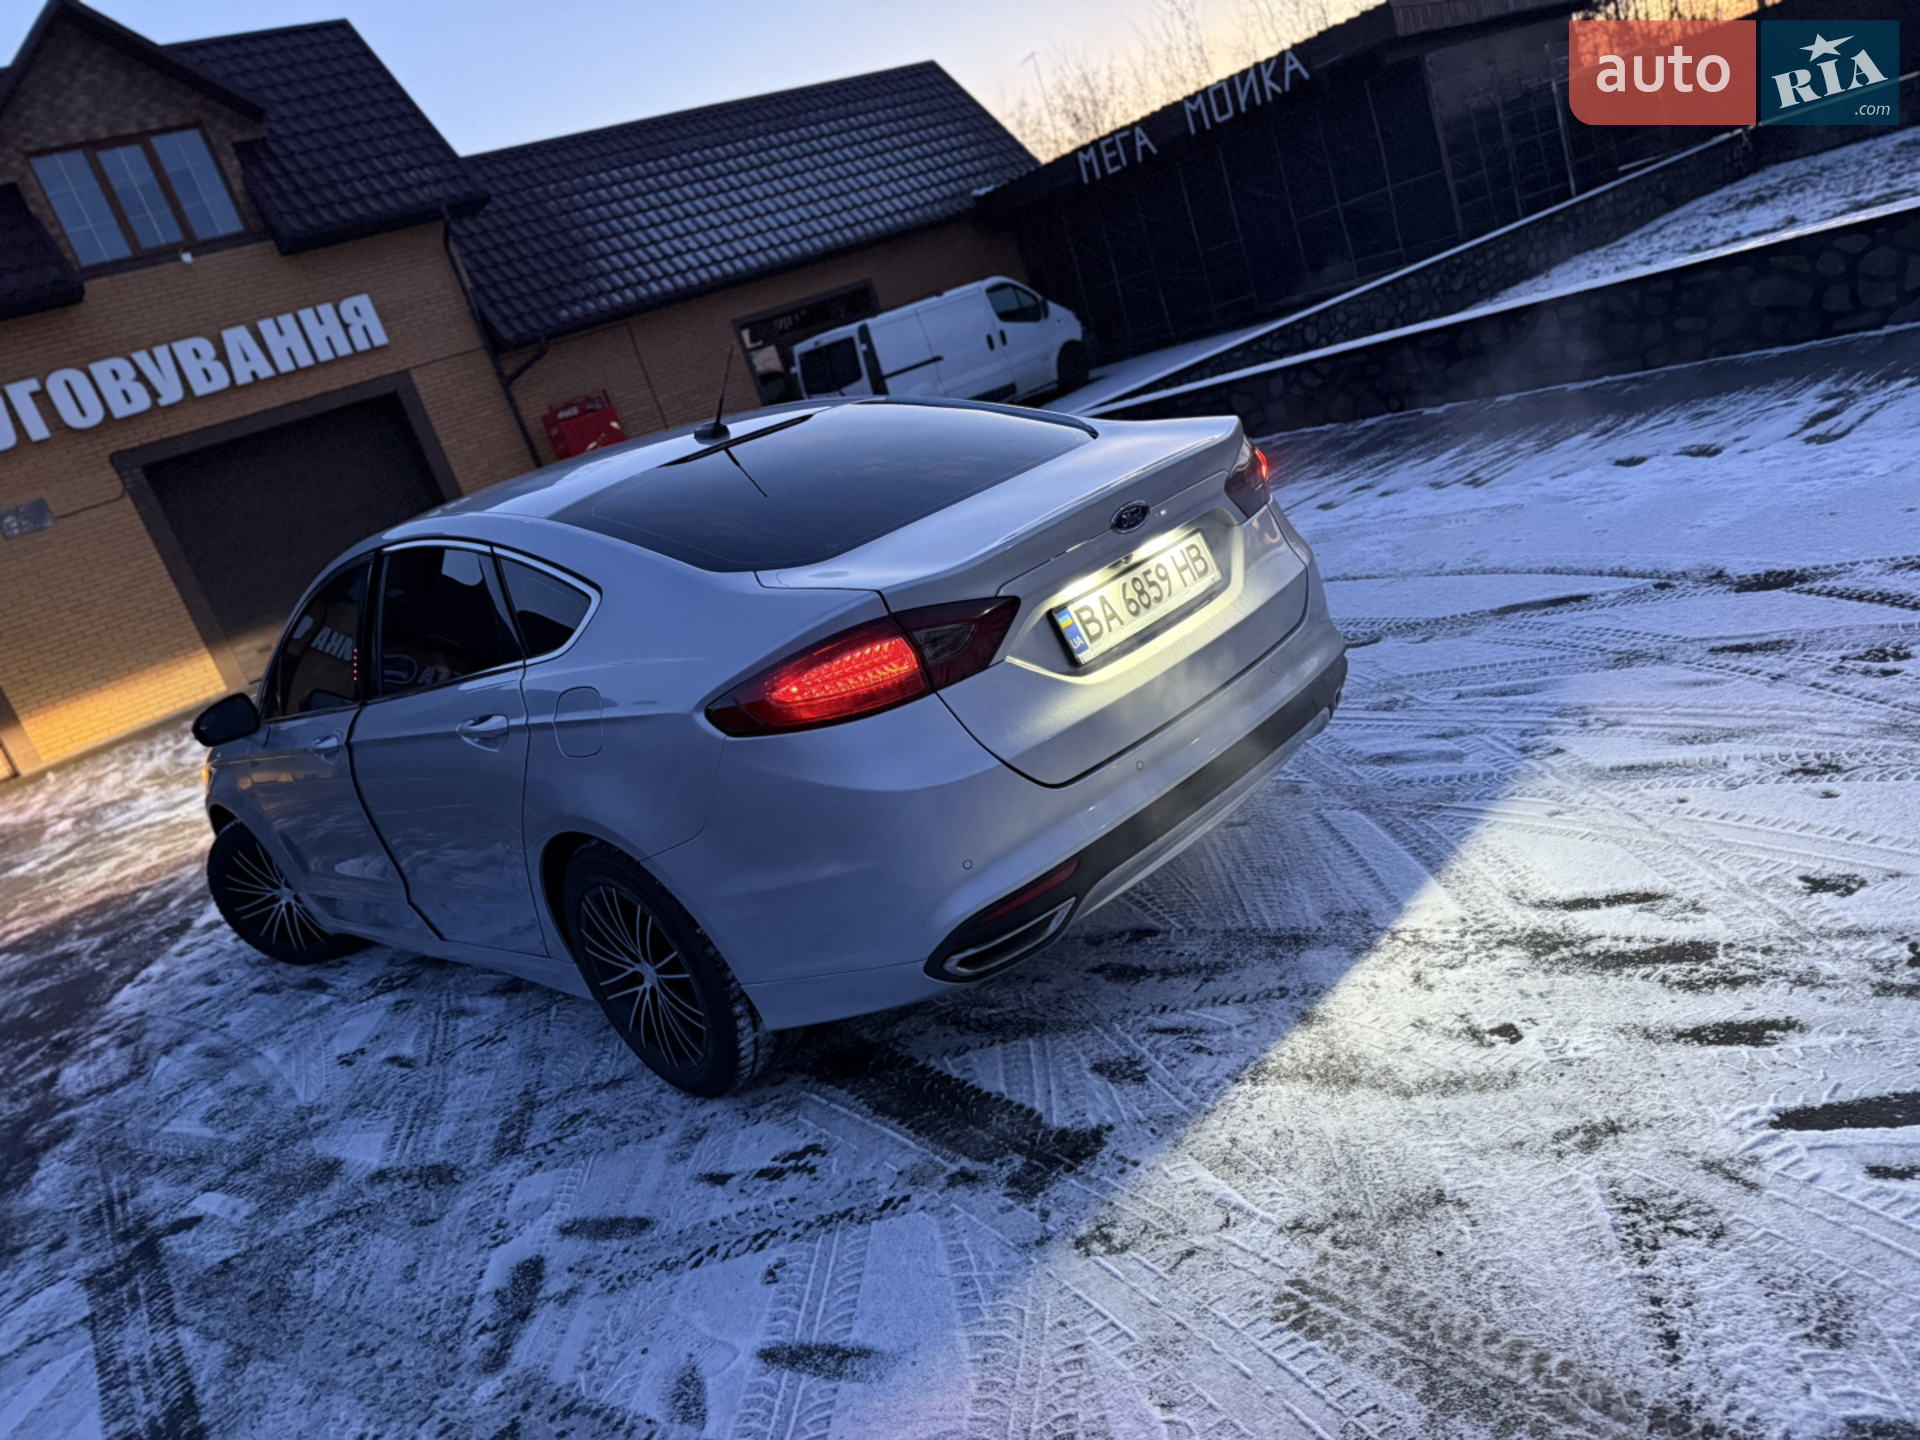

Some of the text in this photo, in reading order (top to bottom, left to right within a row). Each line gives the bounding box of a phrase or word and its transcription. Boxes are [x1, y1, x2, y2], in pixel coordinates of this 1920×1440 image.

[1077, 126, 1158, 185] МЕГА
[1074, 543, 1209, 644] BA 6859 HB
[1069, 635, 1085, 650] UA
